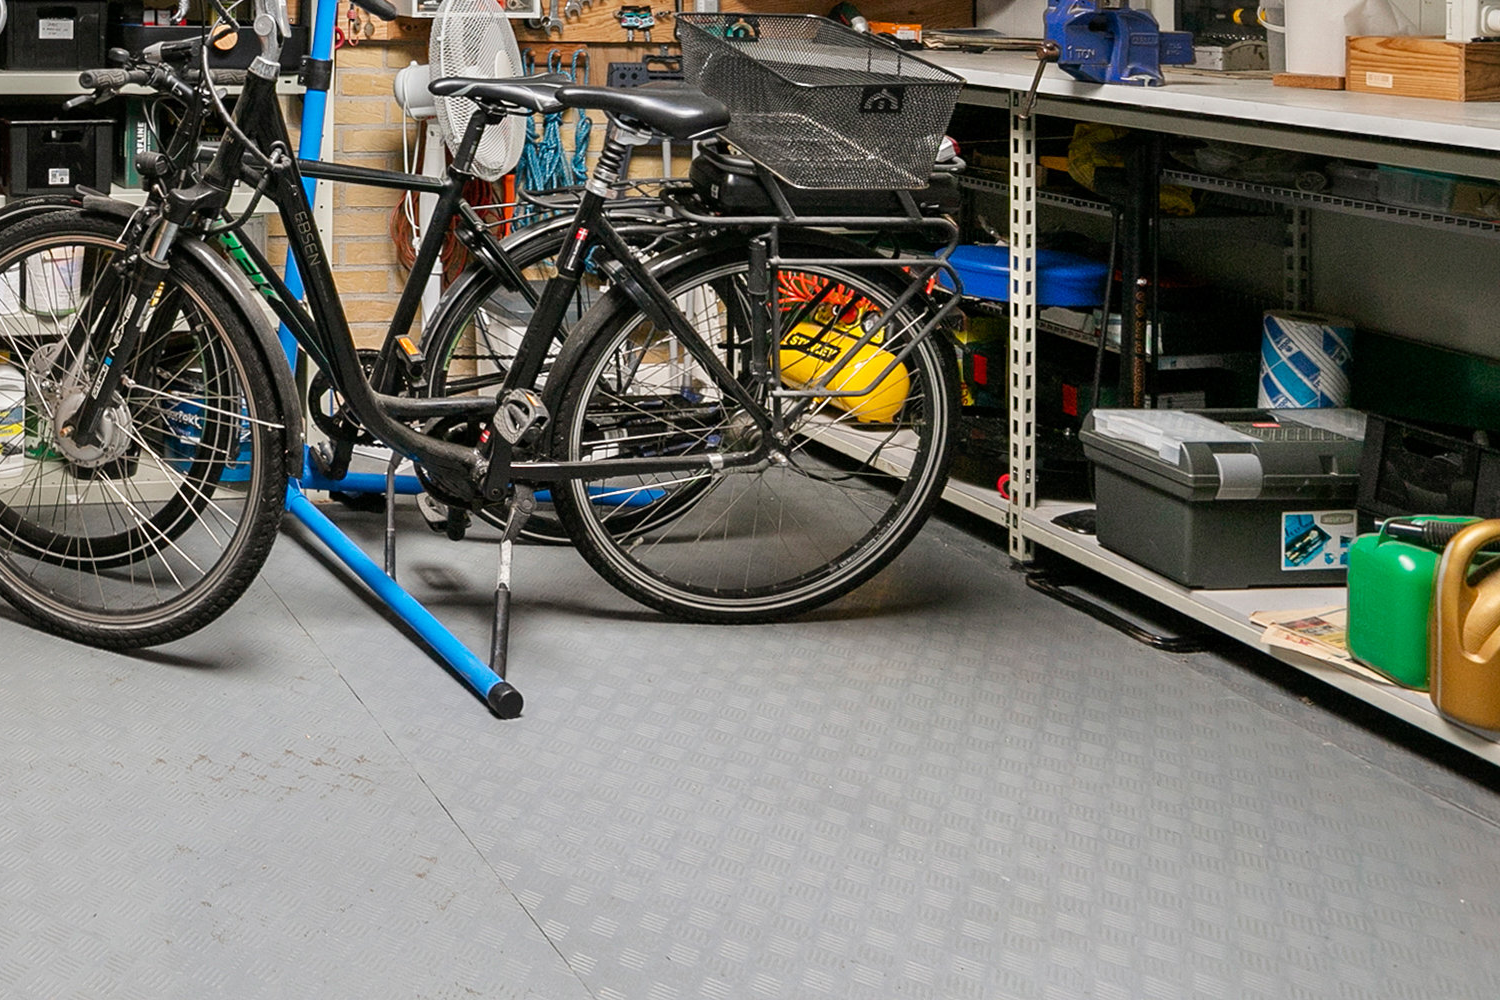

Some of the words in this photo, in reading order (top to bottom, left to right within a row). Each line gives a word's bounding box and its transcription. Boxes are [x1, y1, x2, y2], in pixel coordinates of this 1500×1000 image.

[1075, 48, 1095, 59] TON
[295, 211, 321, 267] EBSEN
[789, 335, 838, 358] STLEY
